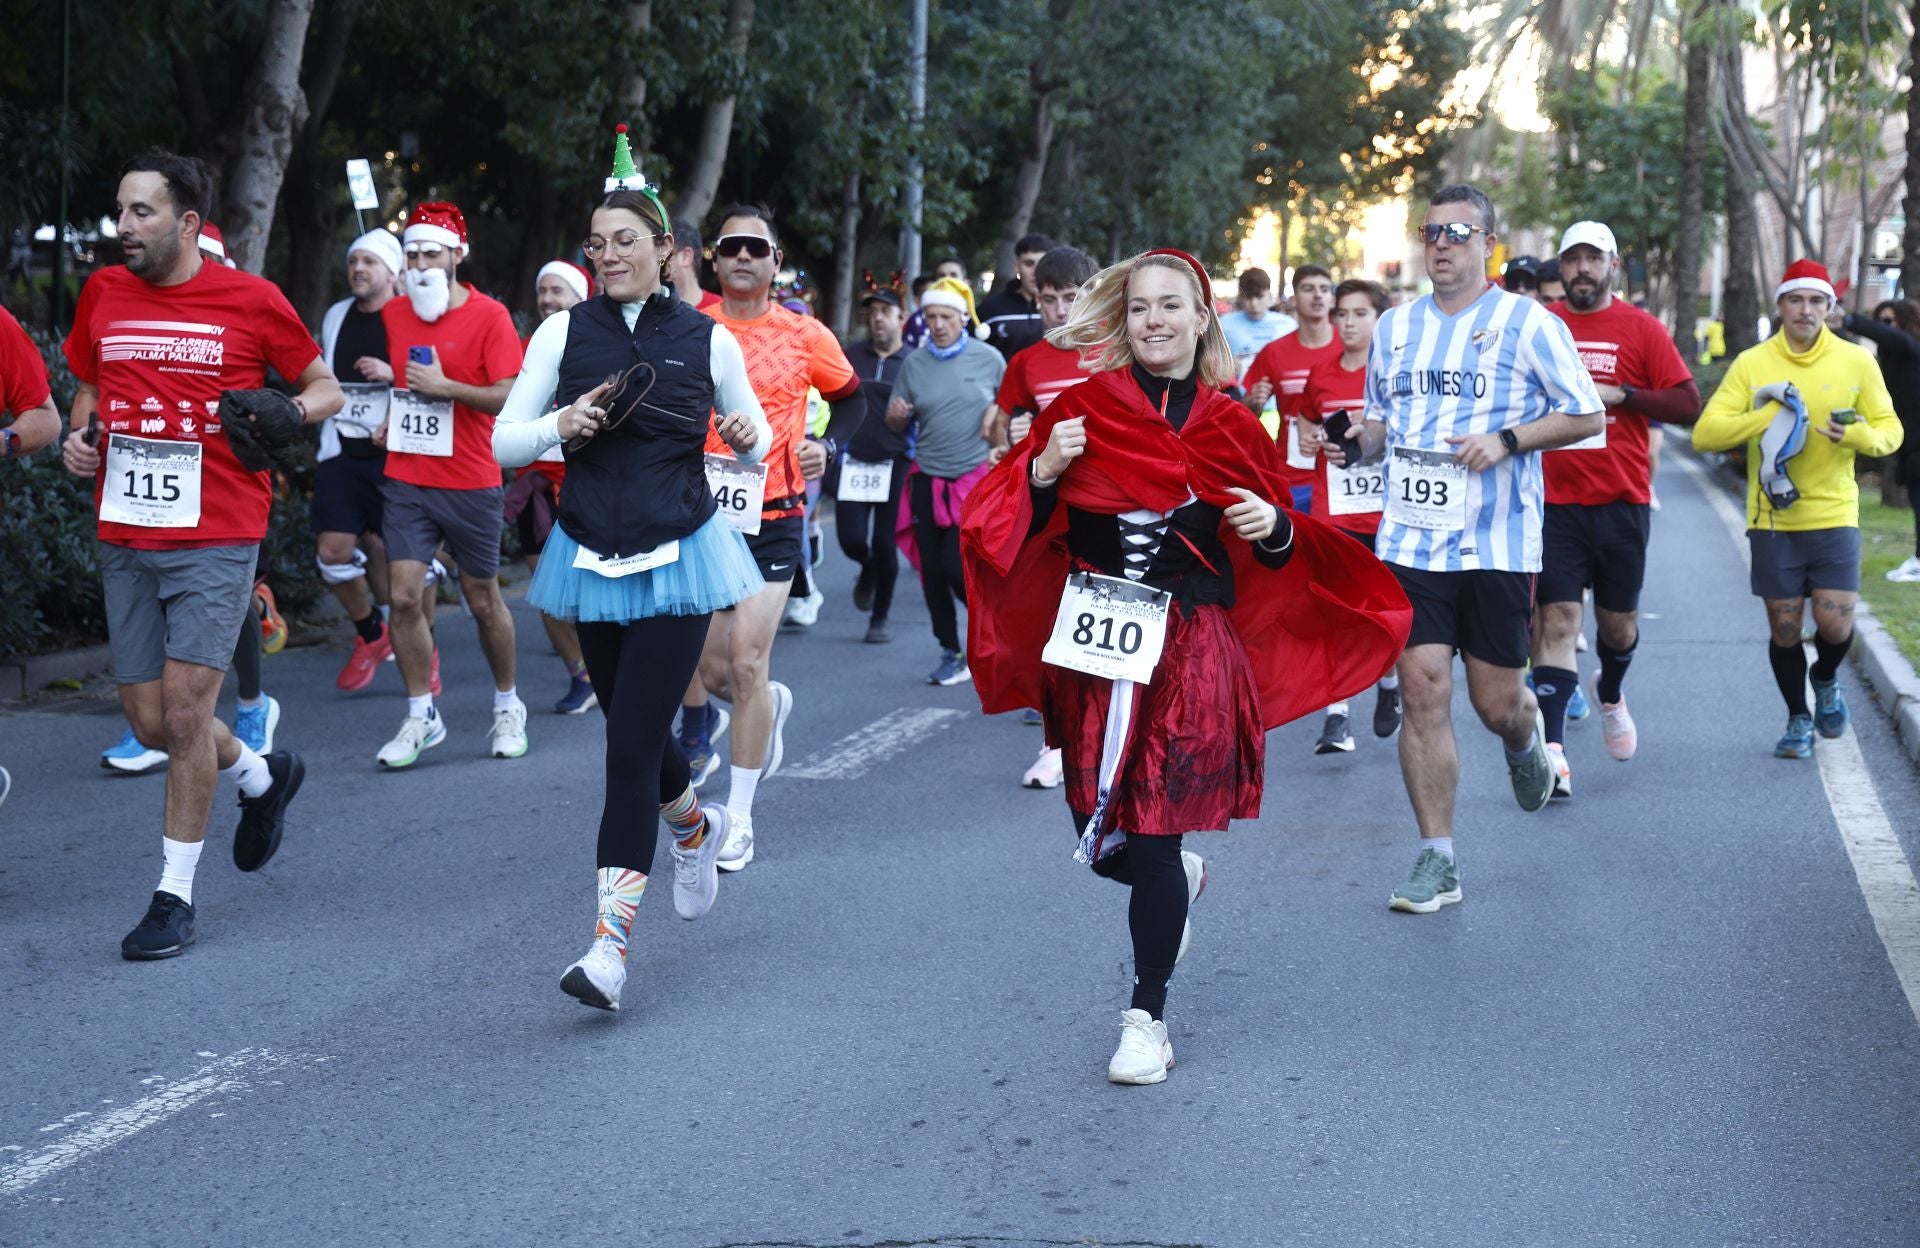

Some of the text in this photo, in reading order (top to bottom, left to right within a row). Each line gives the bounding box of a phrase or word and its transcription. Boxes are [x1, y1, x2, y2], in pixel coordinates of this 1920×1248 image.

[154, 344, 224, 357] SAN SILVESTRE
[172, 337, 224, 351] CARRERA
[128, 351, 223, 366] PALMA PALMILLA
[1419, 370, 1486, 399] UNESCO
[401, 414, 439, 436] 418
[123, 470, 181, 502] 115
[850, 474, 881, 489] 638
[1343, 475, 1383, 496] 192
[1401, 476, 1449, 506] 193
[1072, 612, 1143, 655] 810
